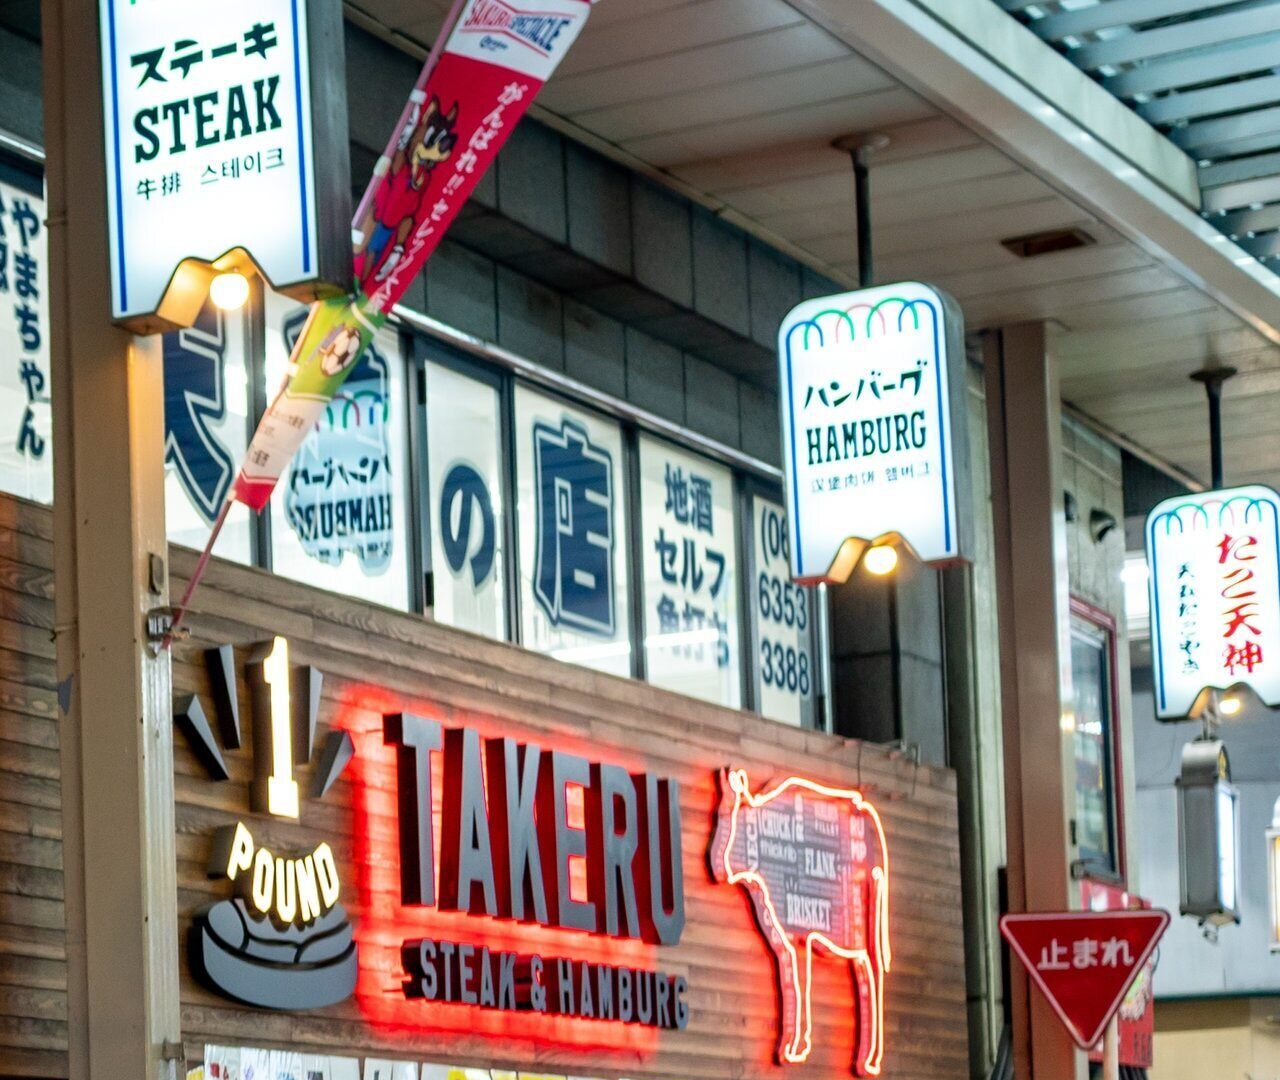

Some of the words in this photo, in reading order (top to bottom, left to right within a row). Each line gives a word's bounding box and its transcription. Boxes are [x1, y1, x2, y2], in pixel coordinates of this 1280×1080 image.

[130, 22, 279, 89] ステーキ
[133, 75, 283, 165] STEAK
[136, 173, 182, 200] 牛排
[200, 147, 286, 187] 스테이크
[11, 196, 46, 463] やまちゃん
[802, 360, 929, 411] ハンバーグ
[806, 410, 928, 466] HAMBURG
[663, 461, 714, 537] 地酒
[654, 532, 726, 601] セルフ
[758, 571, 809, 632] 6353
[1216, 532, 1264, 678] たこ天神
[760, 638, 811, 698] 3388
[384, 711, 687, 947] TAKERU
[226, 820, 341, 926] POUND
[786, 892, 833, 933] BRISKET
[419, 938, 517, 1003] STEAK
[529, 957, 546, 1011] &
[557, 963, 691, 1032] HAMBURG
[1037, 936, 1136, 971] 止まれ
